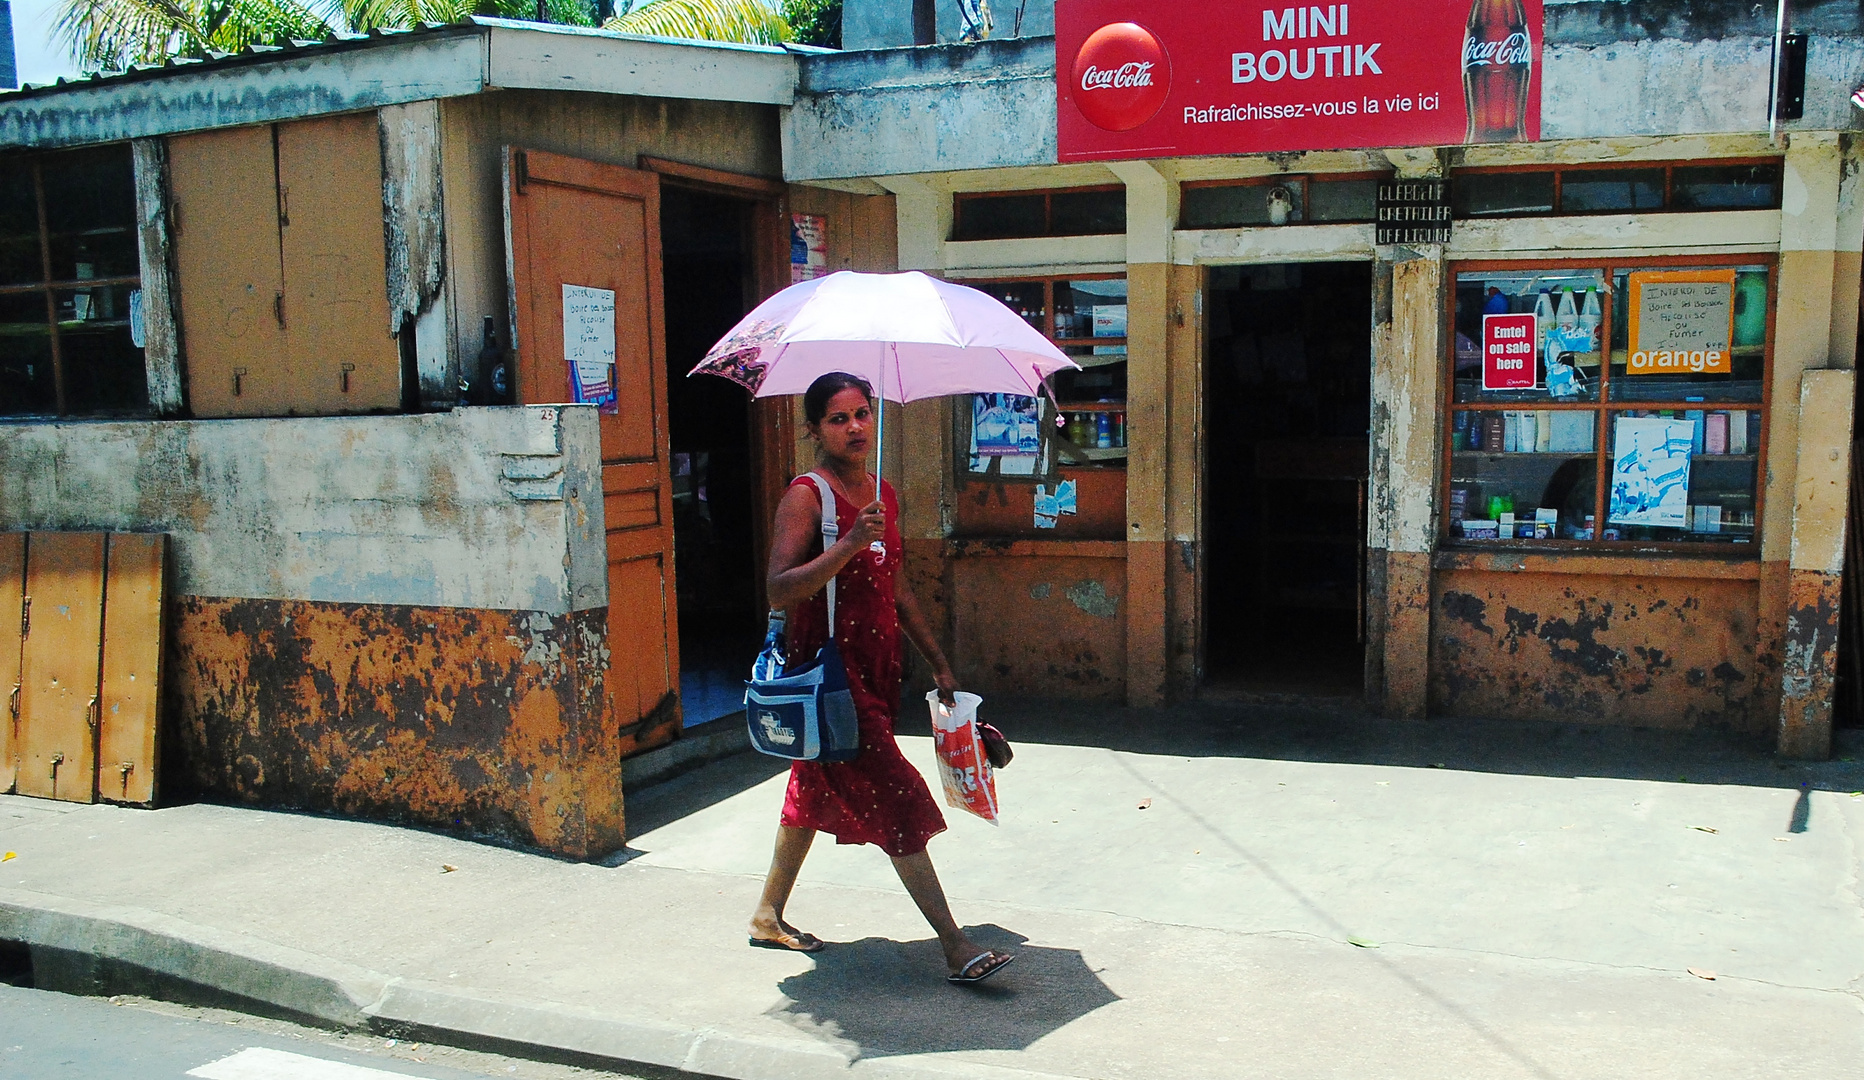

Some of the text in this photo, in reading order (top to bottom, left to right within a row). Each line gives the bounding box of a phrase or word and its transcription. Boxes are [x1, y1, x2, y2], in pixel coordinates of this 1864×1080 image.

[1263, 4, 1348, 41] MINI
[1081, 61, 1155, 91] Coca-Cola
[1231, 43, 1383, 84] BOUTIK
[1183, 92, 1439, 124] Rafraîchissez-vous la vie ici
[1494, 325, 1526, 339] Emtel
[1489, 341, 1531, 355] on sale
[1631, 350, 1721, 372] orange
[1496, 357, 1523, 370] here
